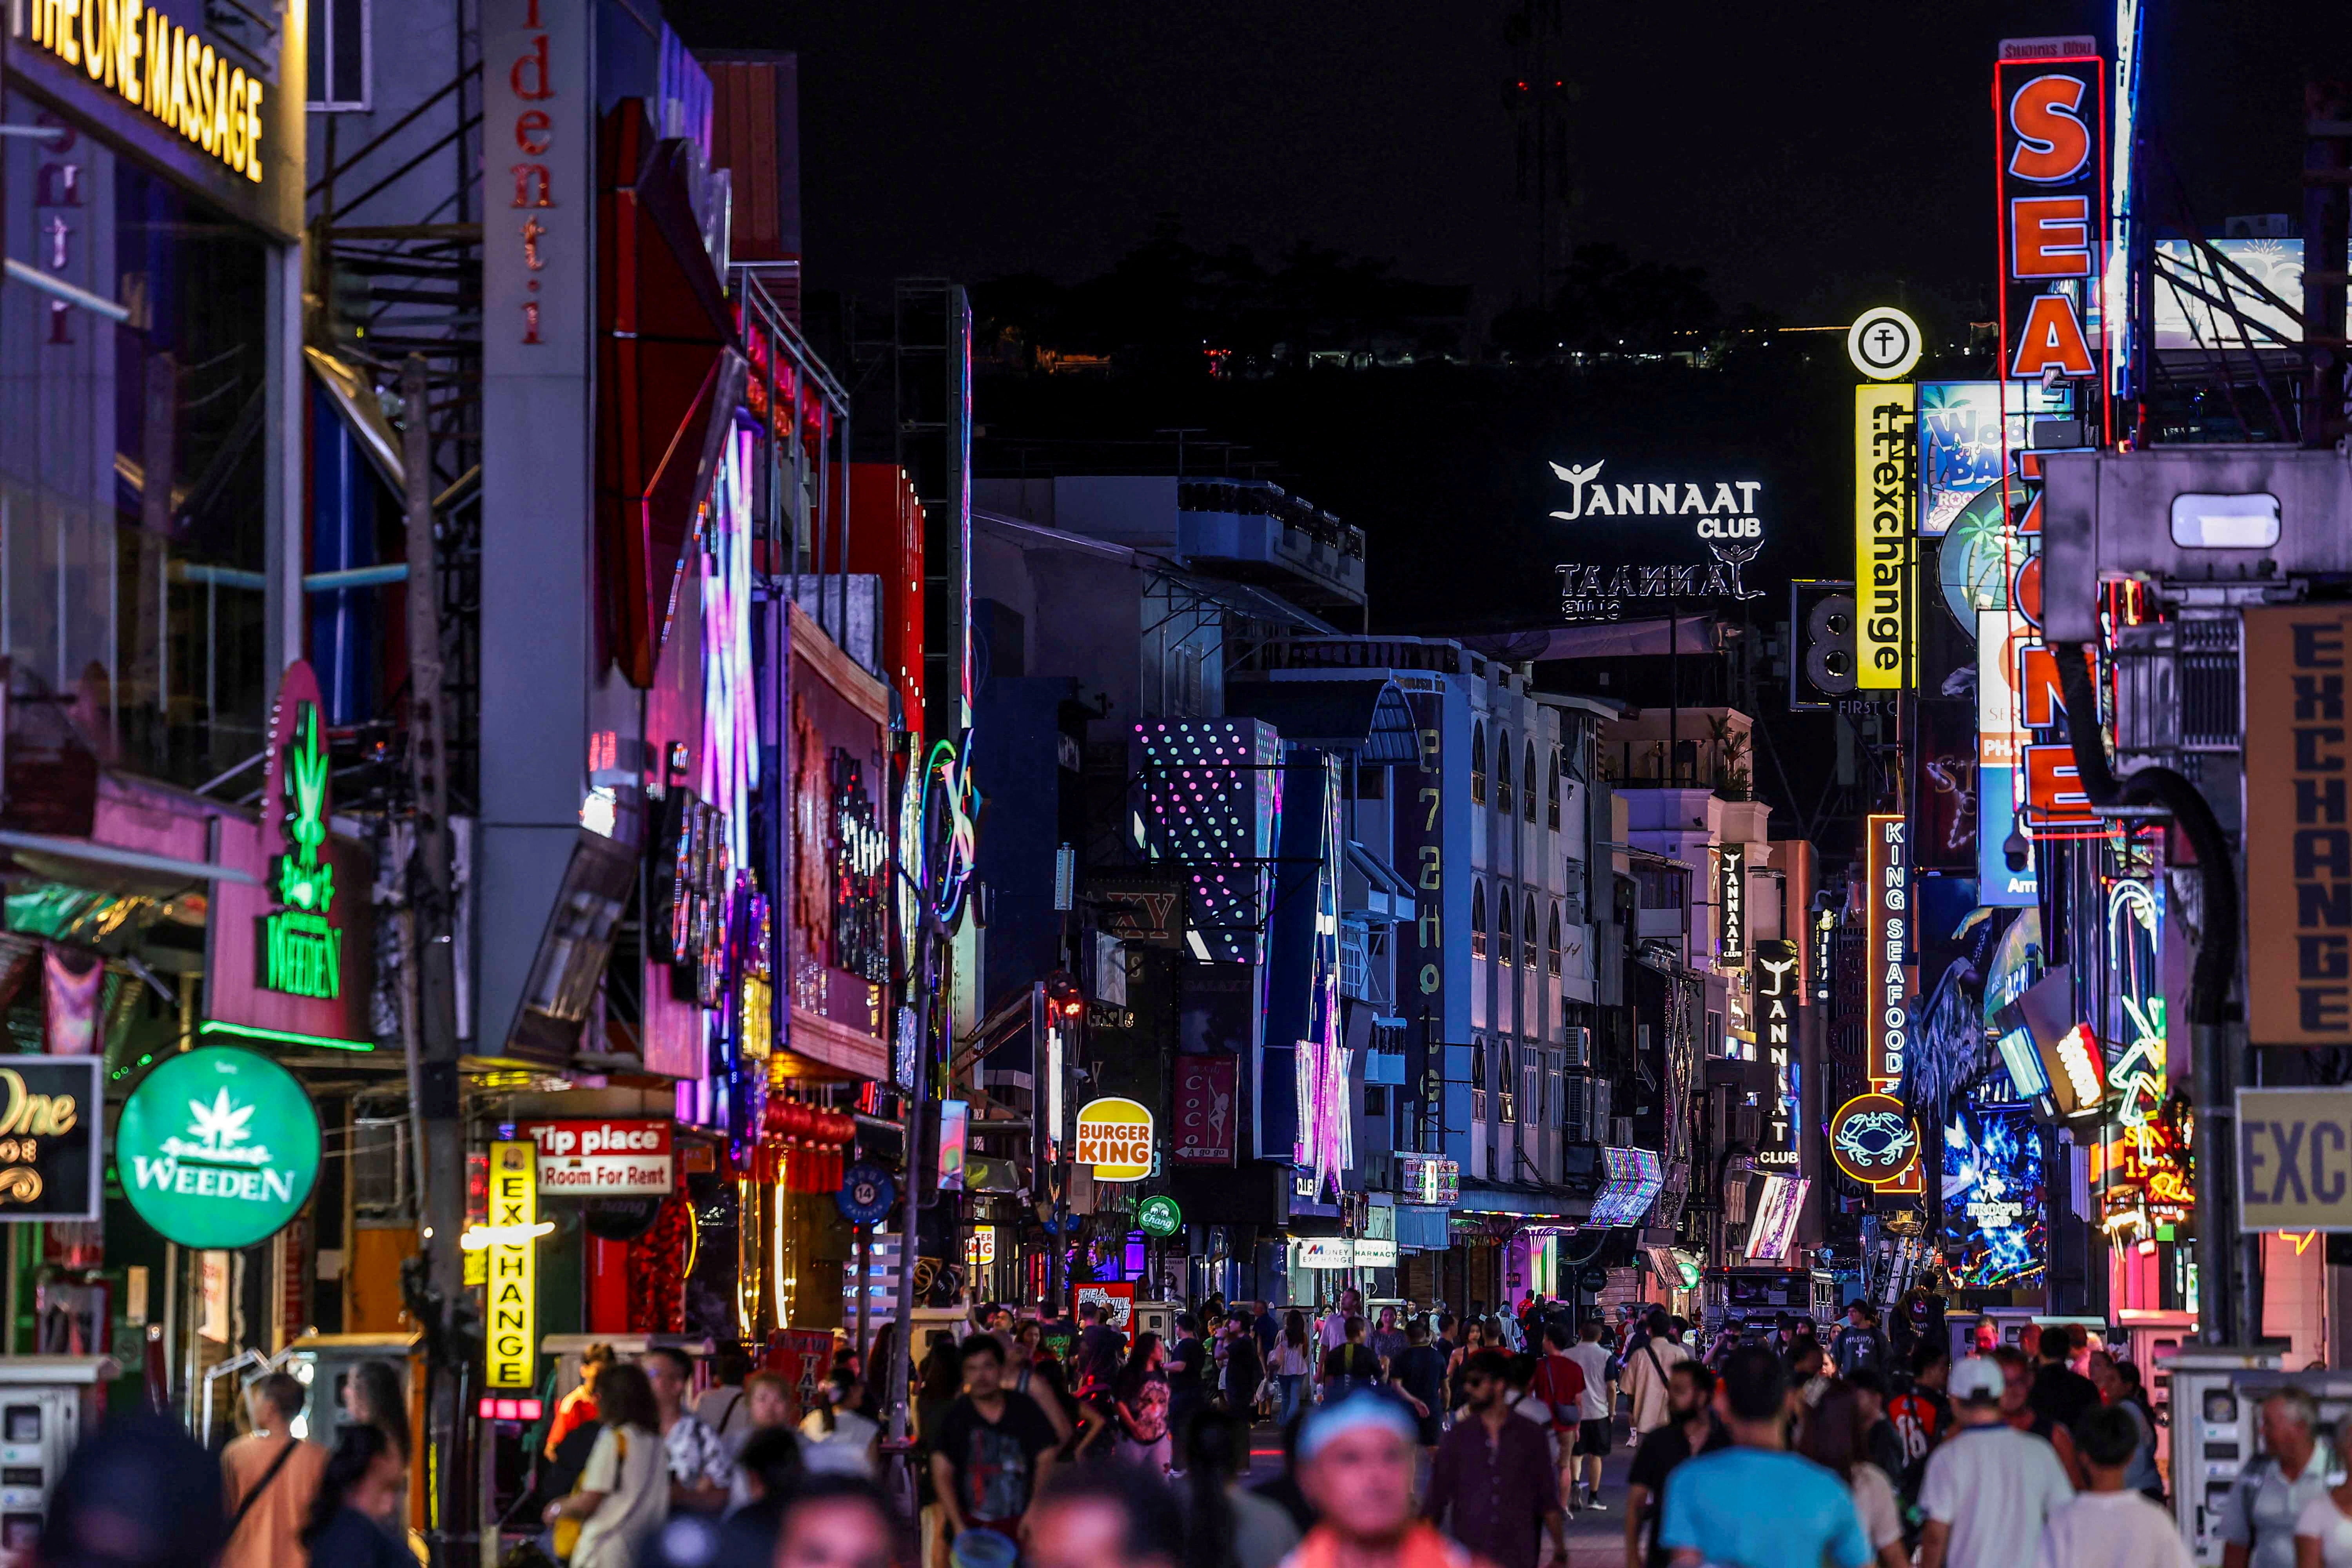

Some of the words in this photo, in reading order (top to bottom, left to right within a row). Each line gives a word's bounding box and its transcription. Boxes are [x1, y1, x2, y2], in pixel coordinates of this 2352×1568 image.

[82, 0, 143, 105] ONE
[143, 6, 263, 183] MASSAGE
[2009, 74, 2096, 378] SEA
[1945, 446, 2017, 486] BA
[1548, 459, 1761, 520] JANNAAT
[1938, 492, 1978, 506] ROO
[1697, 518, 1762, 539] CLUB
[1839, 701, 1880, 715] FIRST
[1984, 739, 2032, 756] PHA
[2291, 622, 2352, 1032] EXCHANGE
[1886, 822, 1905, 911] KING
[1722, 853, 1741, 951] JANNAAT
[1885, 918, 1905, 1074] SEAFOOD
[530, 1125, 575, 1155] Tip
[582, 1124, 659, 1155] place
[1079, 1124, 1149, 1141] BURGER
[1079, 1140, 1149, 1164] KING
[1199, 1149, 1210, 1157] go
[1213, 1149, 1225, 1157] go
[1760, 1151, 1799, 1164] CLUB
[2242, 1121, 2352, 1205] EXC
[132, 1154, 296, 1203] WEEDEN
[546, 1169, 591, 1185] Room
[596, 1168, 624, 1185] For
[628, 1168, 665, 1185] Rent
[858, 1187, 871, 1198] 14
[1142, 1213, 1172, 1229] Chang
[1308, 1244, 1348, 1255] MONEY
[1079, 1289, 1097, 1299] THE
